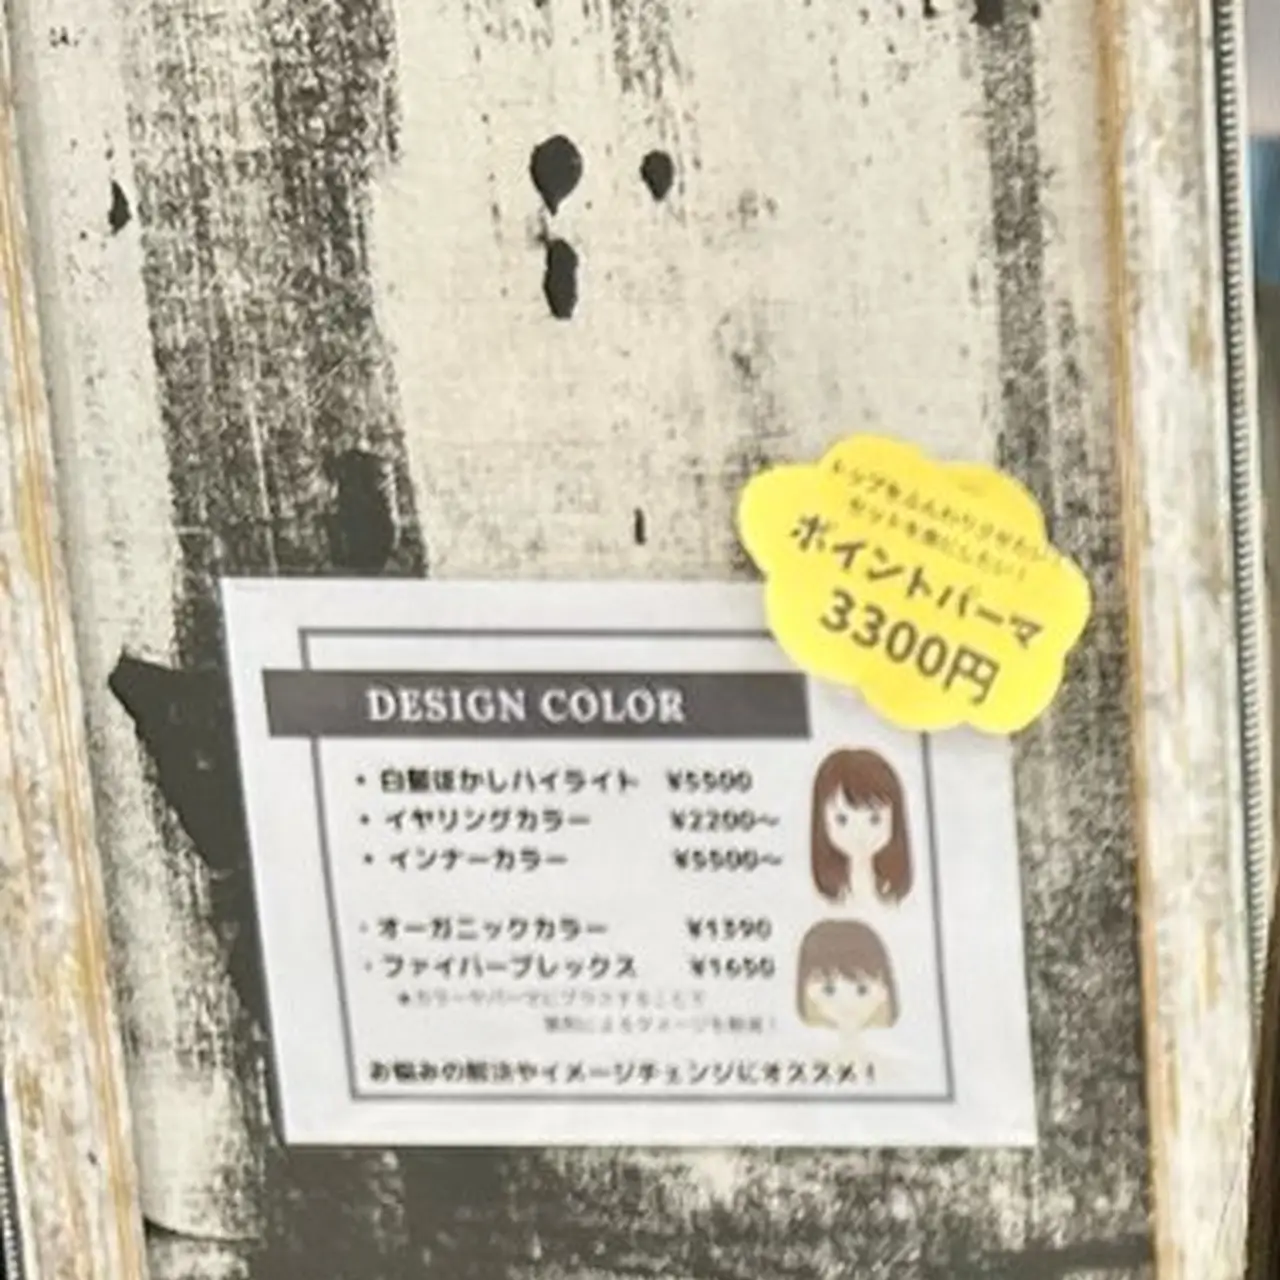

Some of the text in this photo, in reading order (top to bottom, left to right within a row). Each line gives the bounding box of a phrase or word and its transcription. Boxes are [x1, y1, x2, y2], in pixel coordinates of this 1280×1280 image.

[790, 513, 1044, 649] ポイントパーマ
[819, 587, 1001, 706] 3300円
[365, 686, 687, 723] DESIGN COLOR
[384, 807, 592, 833] イヤリングカラー
[389, 847, 569, 872] インナーカラー
[376, 916, 609, 942] オーガニックカラー
